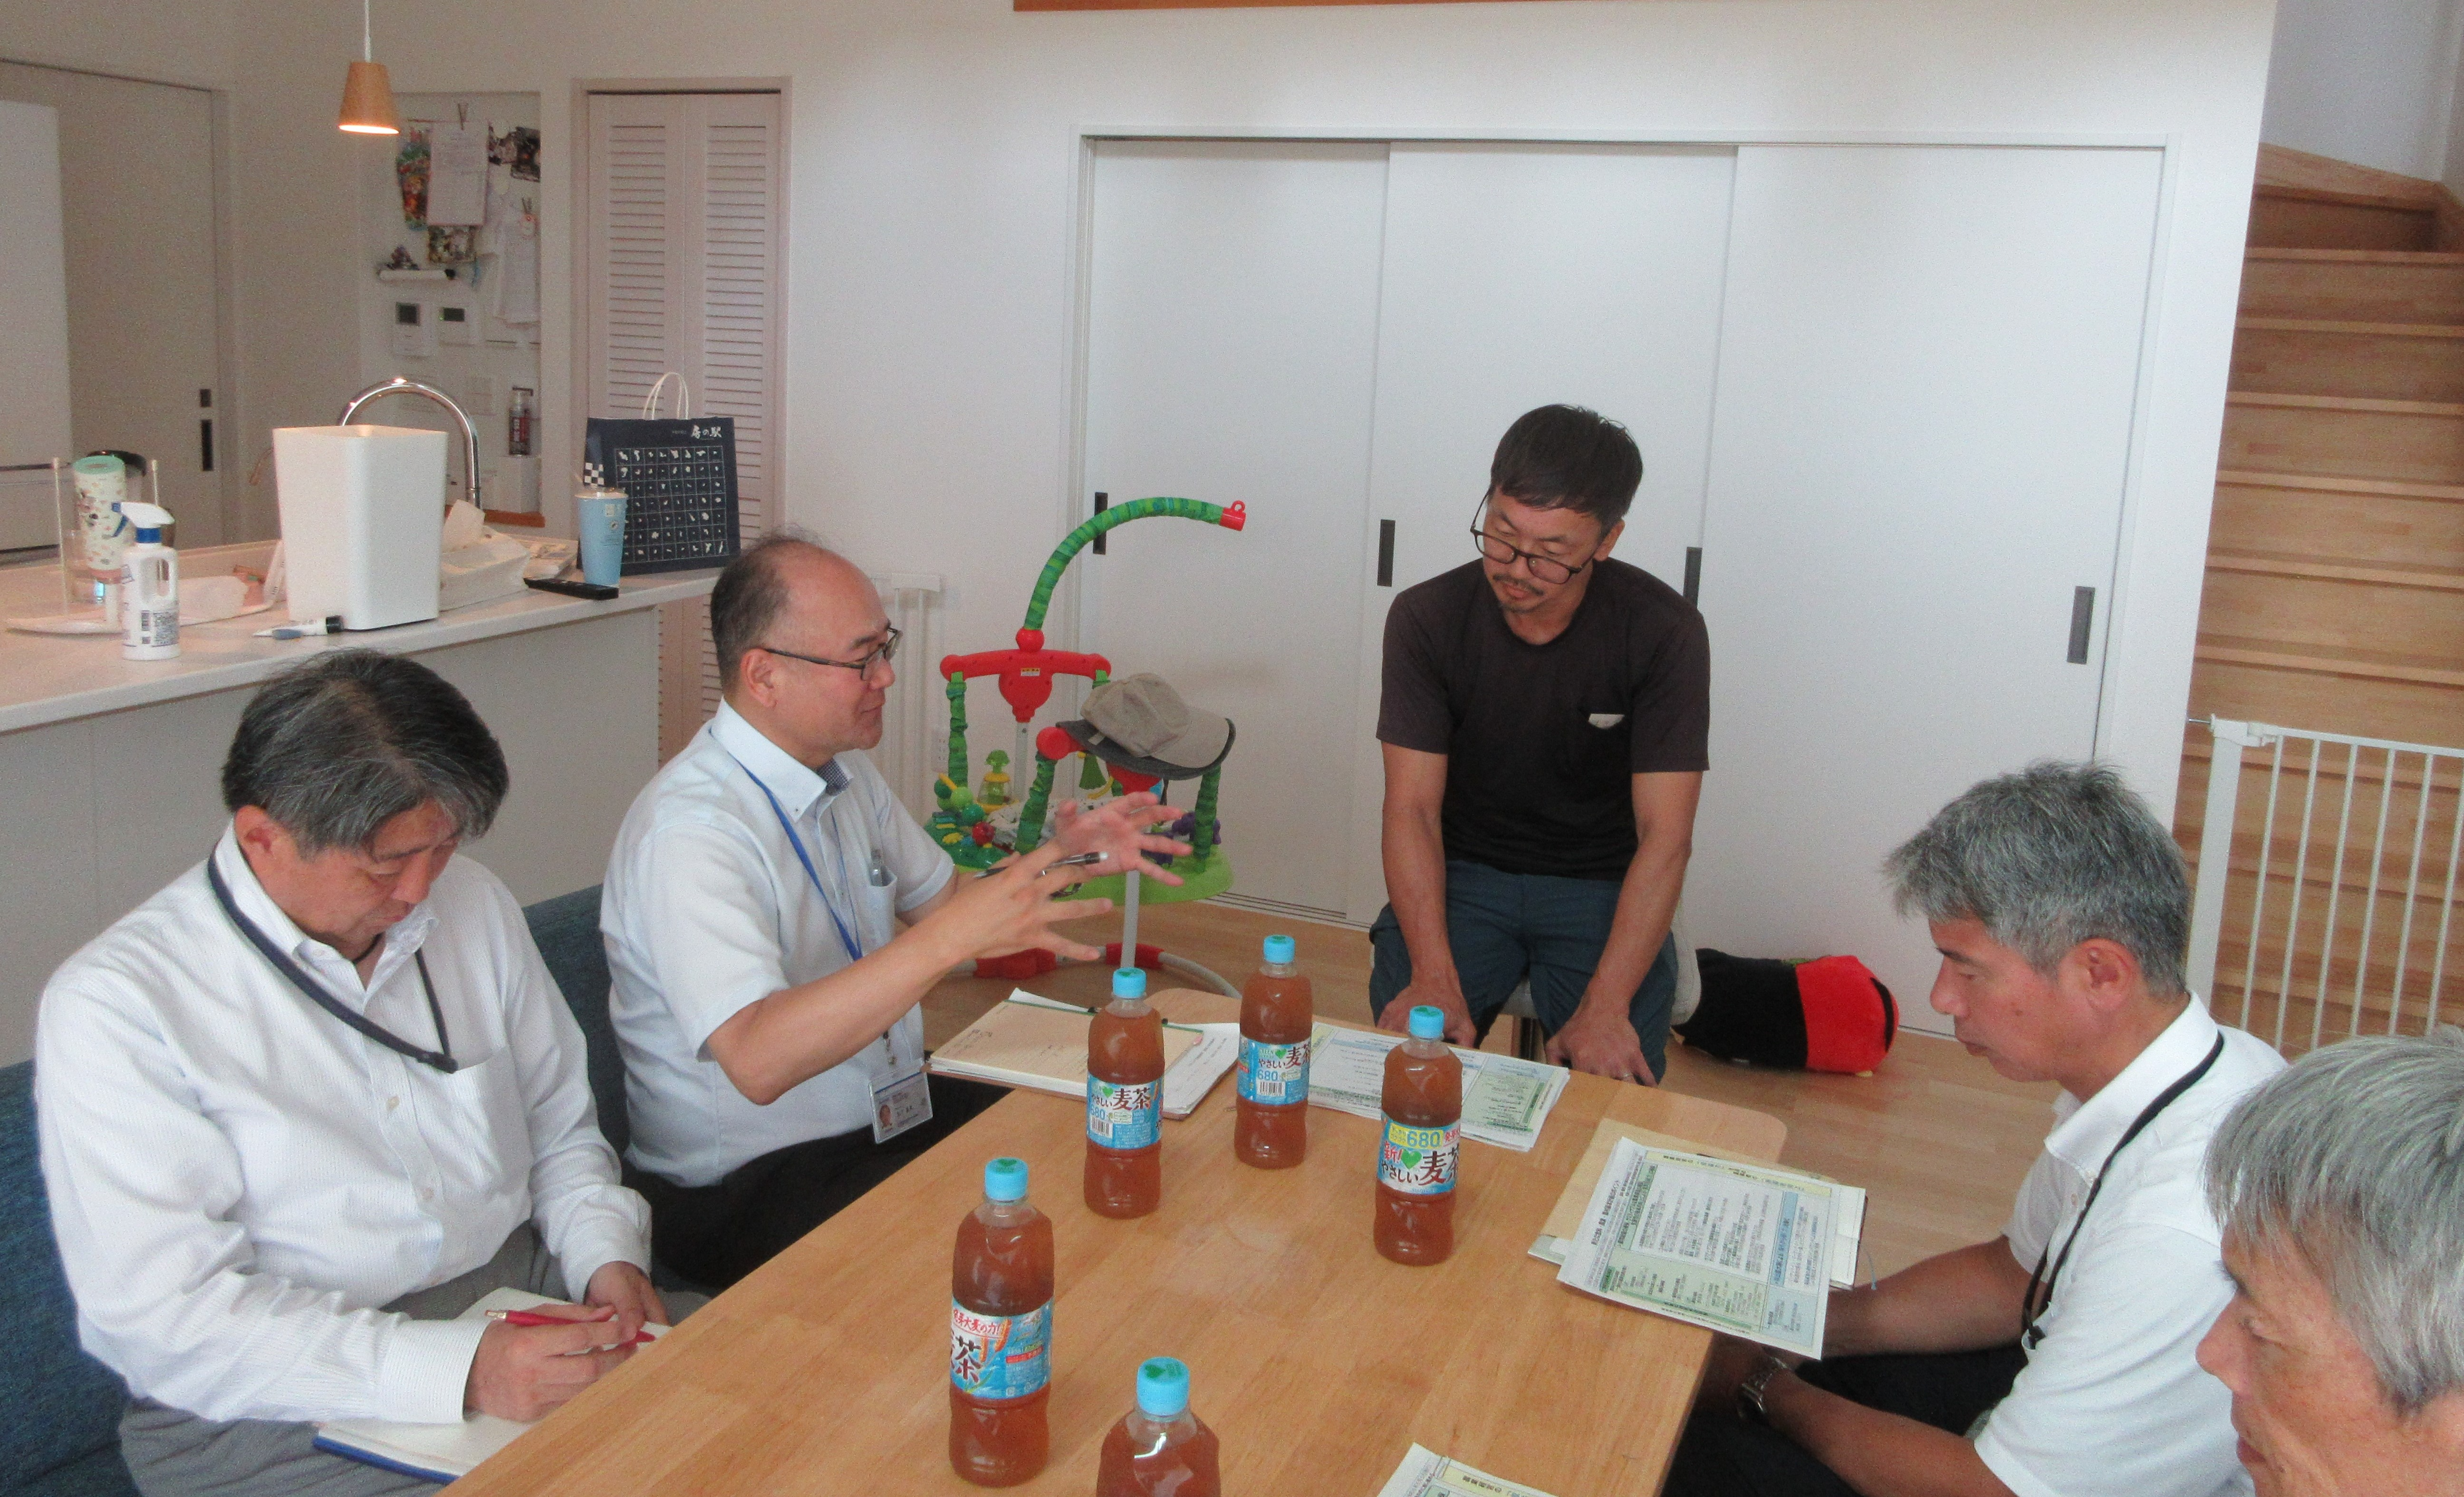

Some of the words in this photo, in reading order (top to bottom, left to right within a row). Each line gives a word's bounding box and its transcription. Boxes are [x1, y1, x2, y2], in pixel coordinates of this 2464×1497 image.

[1259, 1058, 1285, 1068] やさしい
[1257, 1070, 1278, 1081] 680
[1091, 1093, 1112, 1107] やさしい
[1112, 1087, 1151, 1111] 麦茶
[1091, 1104, 1106, 1120] 680
[1406, 1131, 1441, 1148] 680
[1382, 1160, 1418, 1183] やさしい
